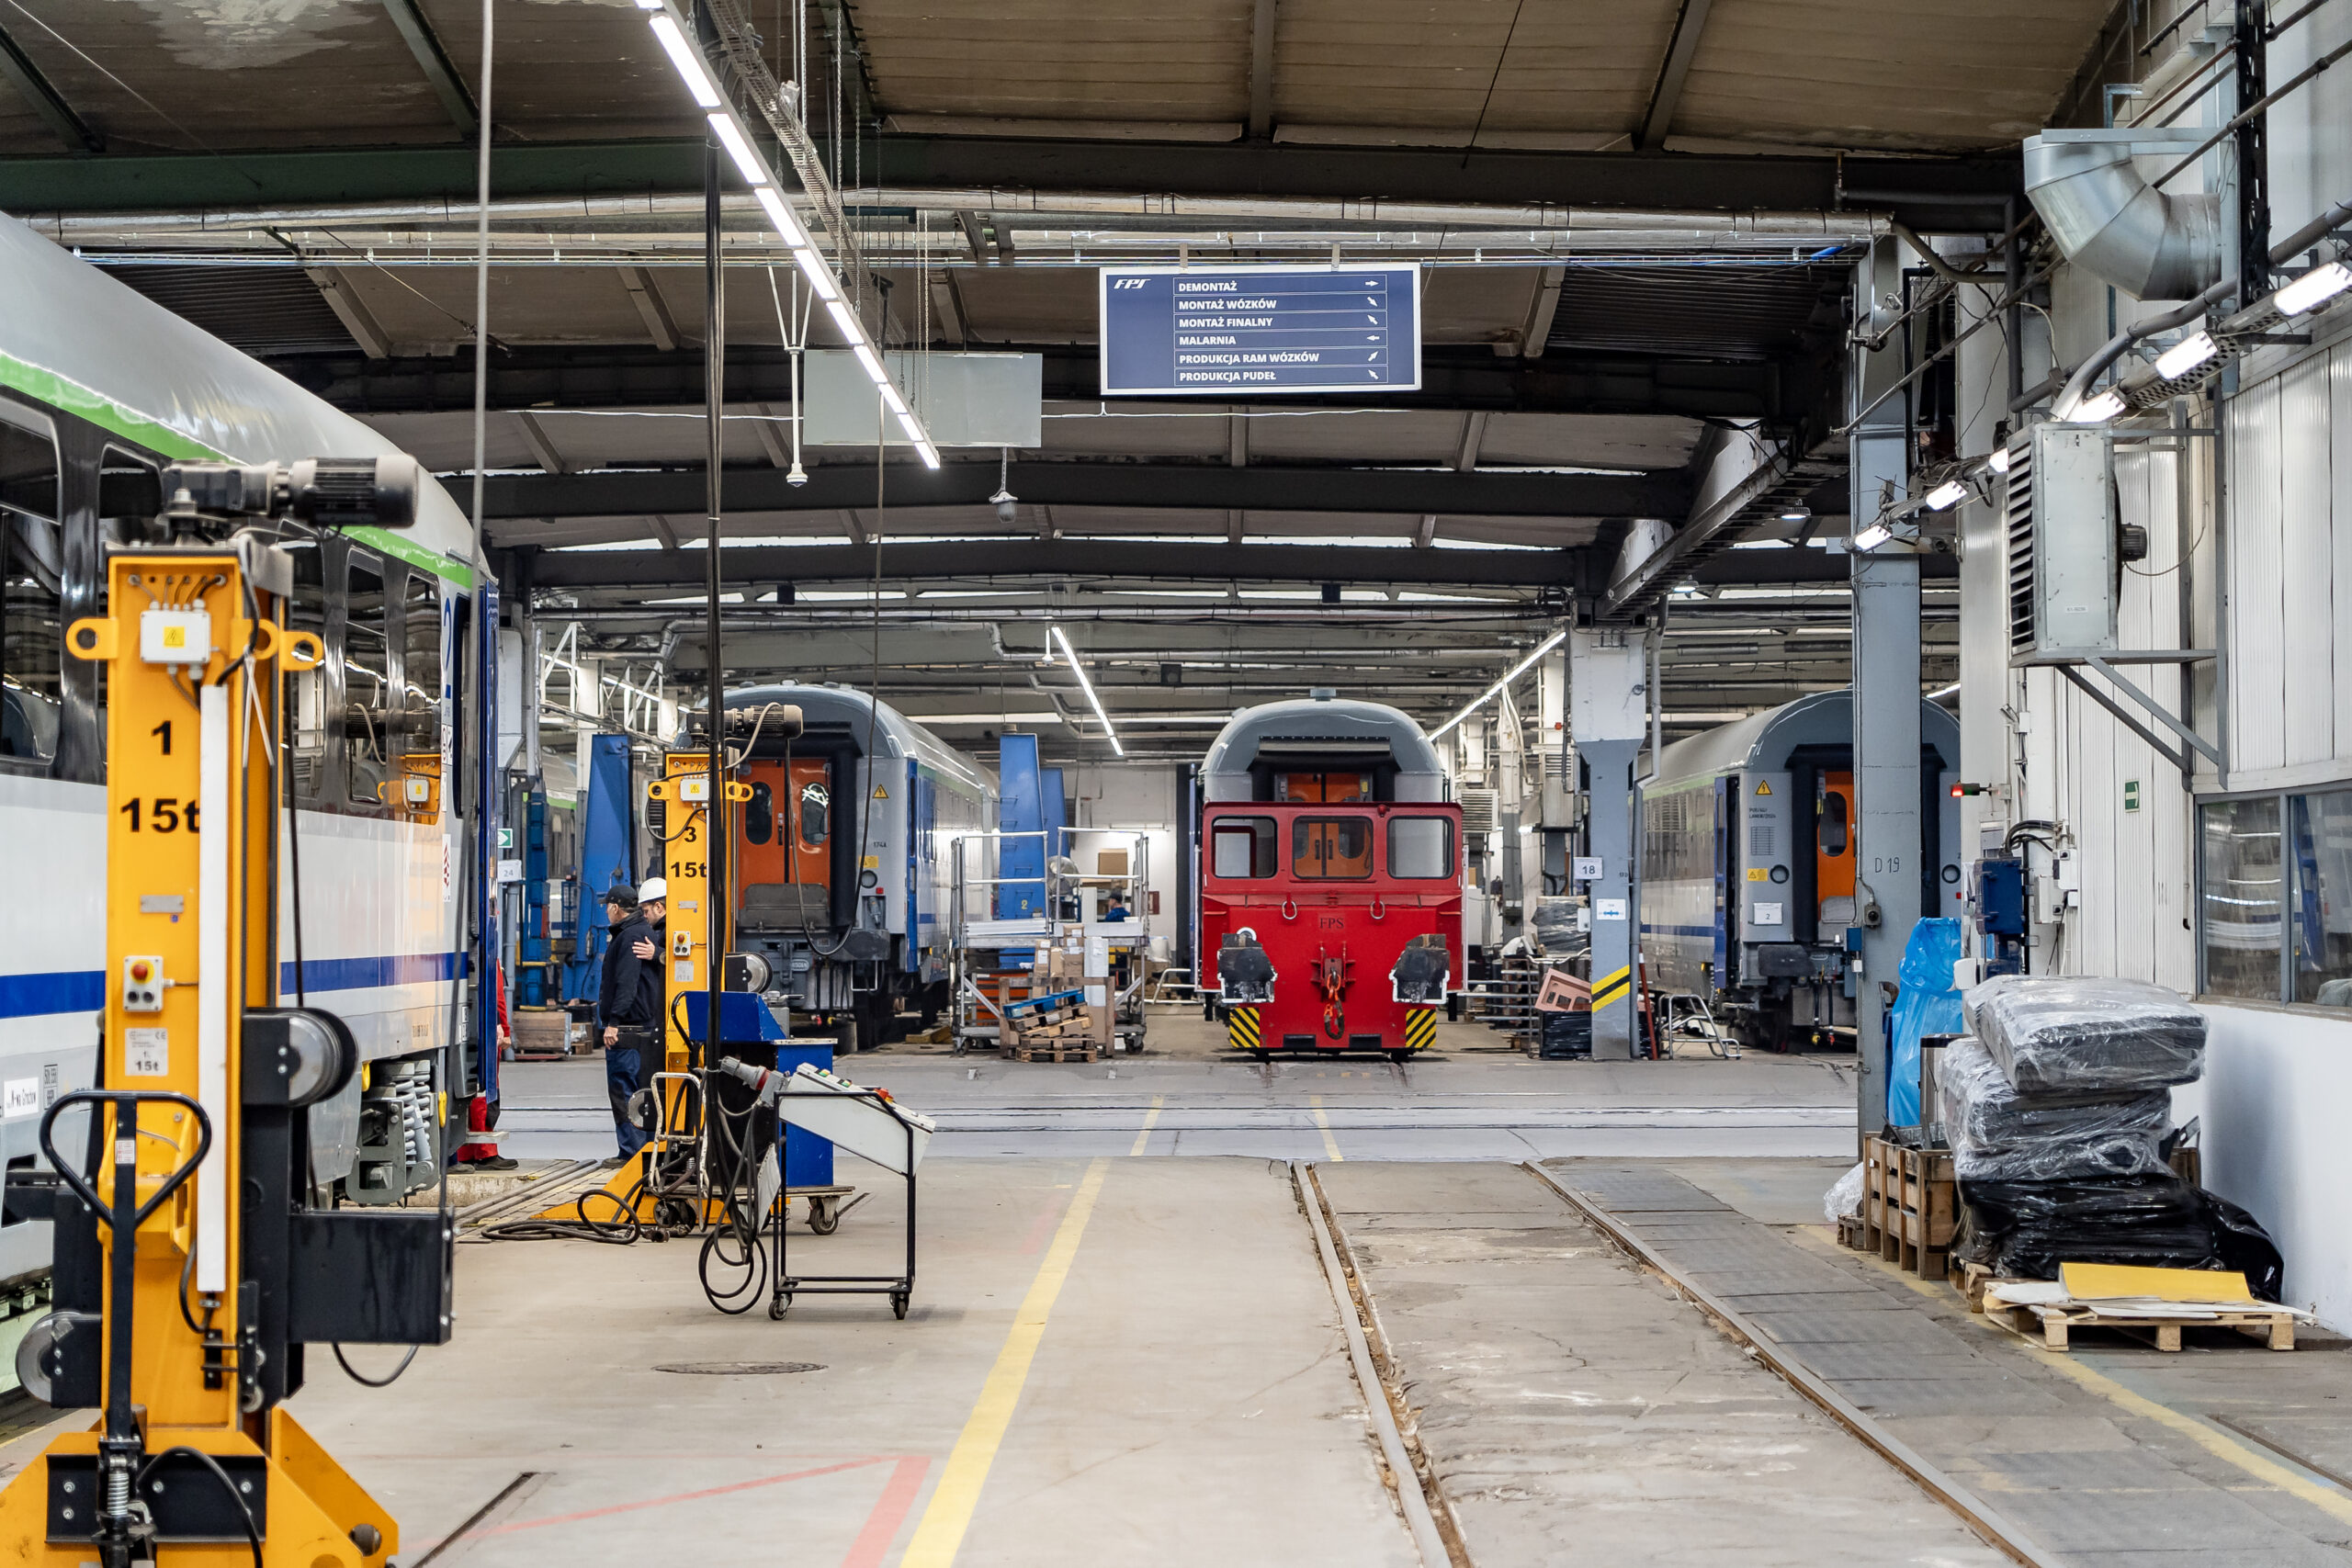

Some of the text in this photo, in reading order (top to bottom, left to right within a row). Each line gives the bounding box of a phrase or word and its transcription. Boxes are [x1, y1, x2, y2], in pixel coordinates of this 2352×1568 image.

[1114, 278, 1151, 289] FPS
[1178, 280, 1238, 292] DEMONTAŻ
[1179, 298, 1277, 310] MONTAŻ WÓZKÓW
[1179, 316, 1273, 328] MONTAŻ FINALNY
[1179, 335, 1237, 345] MALARNIA
[1179, 351, 1320, 366] PRODUKCJA RAM WÓZKÓW
[1180, 371, 1277, 383] PRODUKCJA PUDEŁ
[151, 720, 172, 755] 1
[120, 797, 200, 833] 15t
[684, 826, 697, 843] 3
[670, 862, 707, 878] 15t
[1582, 865, 1596, 874] 18
[1874, 856, 1900, 874] D 19
[1021, 899, 1028, 909] 2
[1319, 918, 1345, 929] FPS
[135, 1060, 159, 1072] 15t
